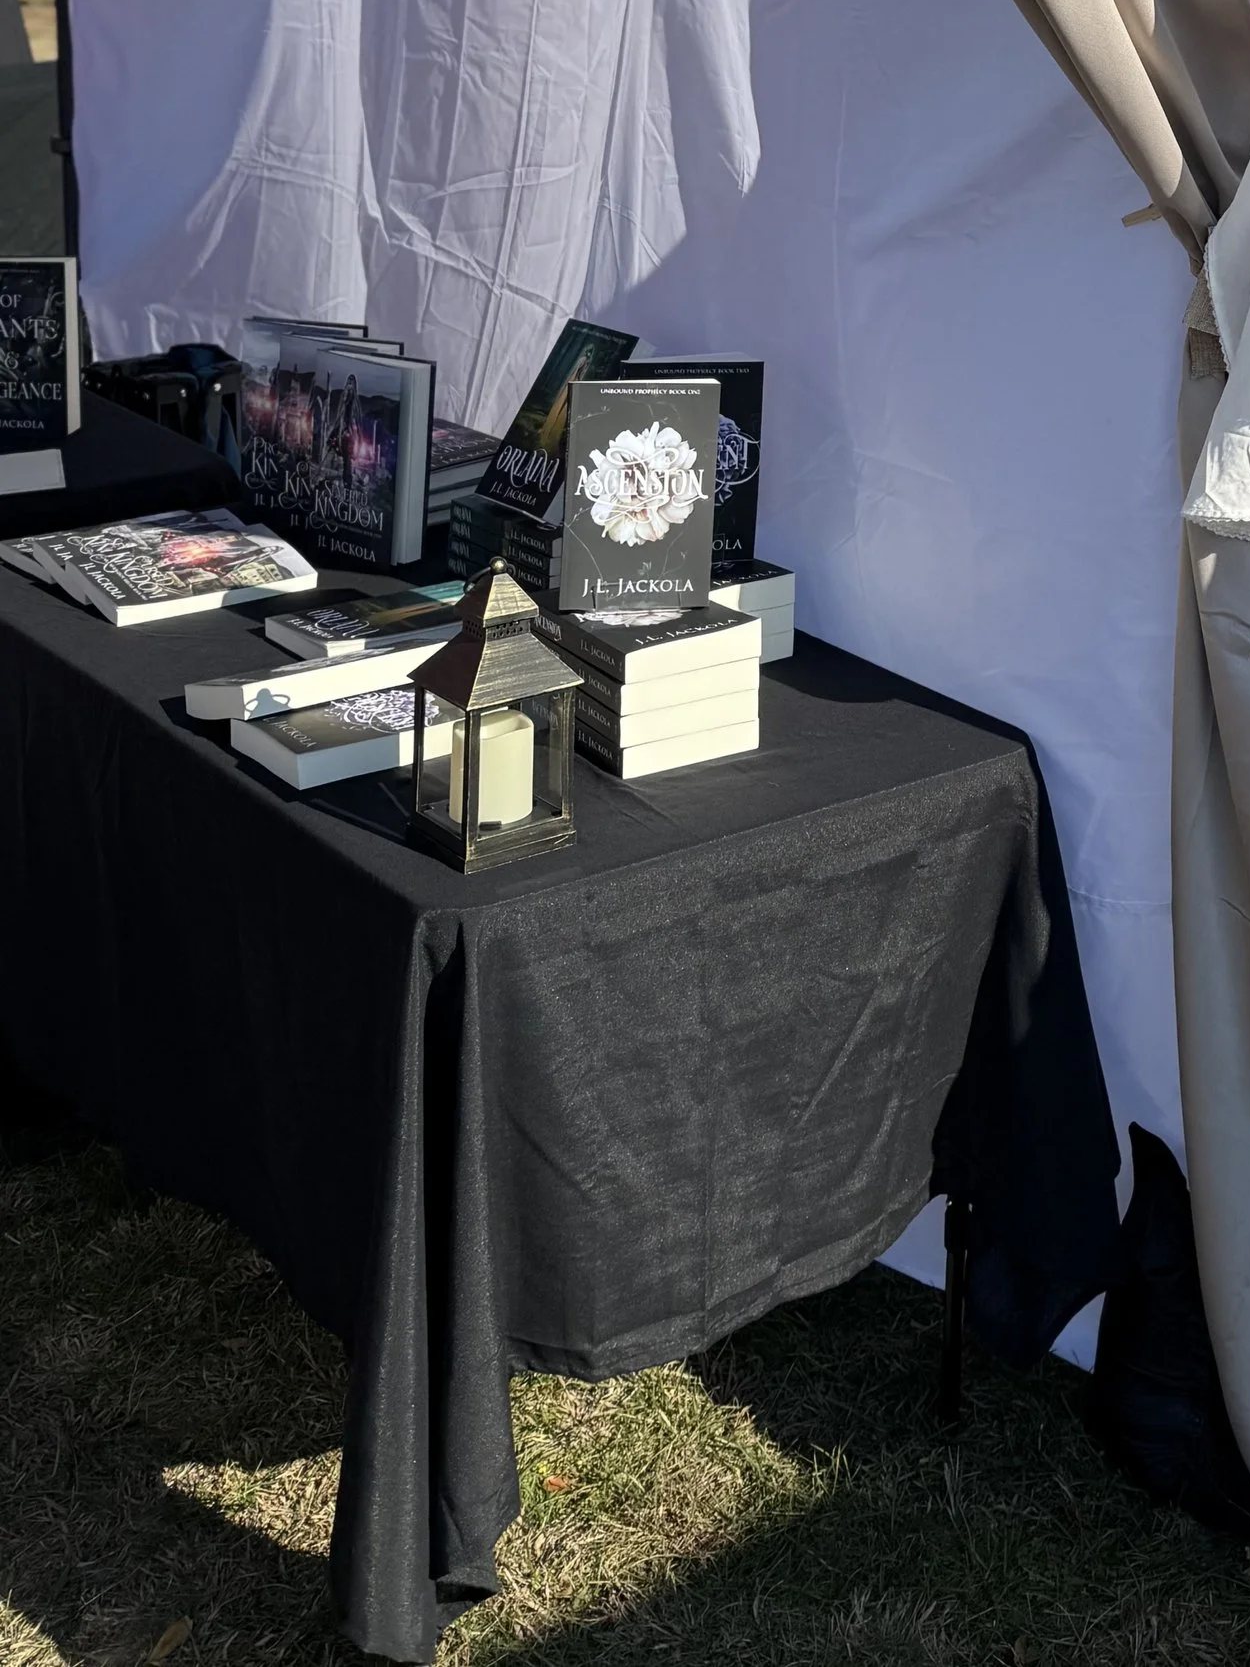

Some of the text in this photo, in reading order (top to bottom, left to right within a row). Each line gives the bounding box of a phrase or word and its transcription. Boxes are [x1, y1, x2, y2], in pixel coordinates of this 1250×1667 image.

[0, 293, 22, 309] OF
[496, 445, 560, 493] ORLAINA
[574, 451, 709, 506] ASCENSION
[311, 489, 384, 532] KINGDOM
[503, 487, 538, 507] JACKOLA
[331, 537, 376, 563] JACKOLA
[87, 570, 127, 600] JACKOLA
[582, 577, 694, 597] J.L. JACKOLA
[665, 619, 739, 638] JACKOLA
[268, 720, 317, 748] JACKOLA
